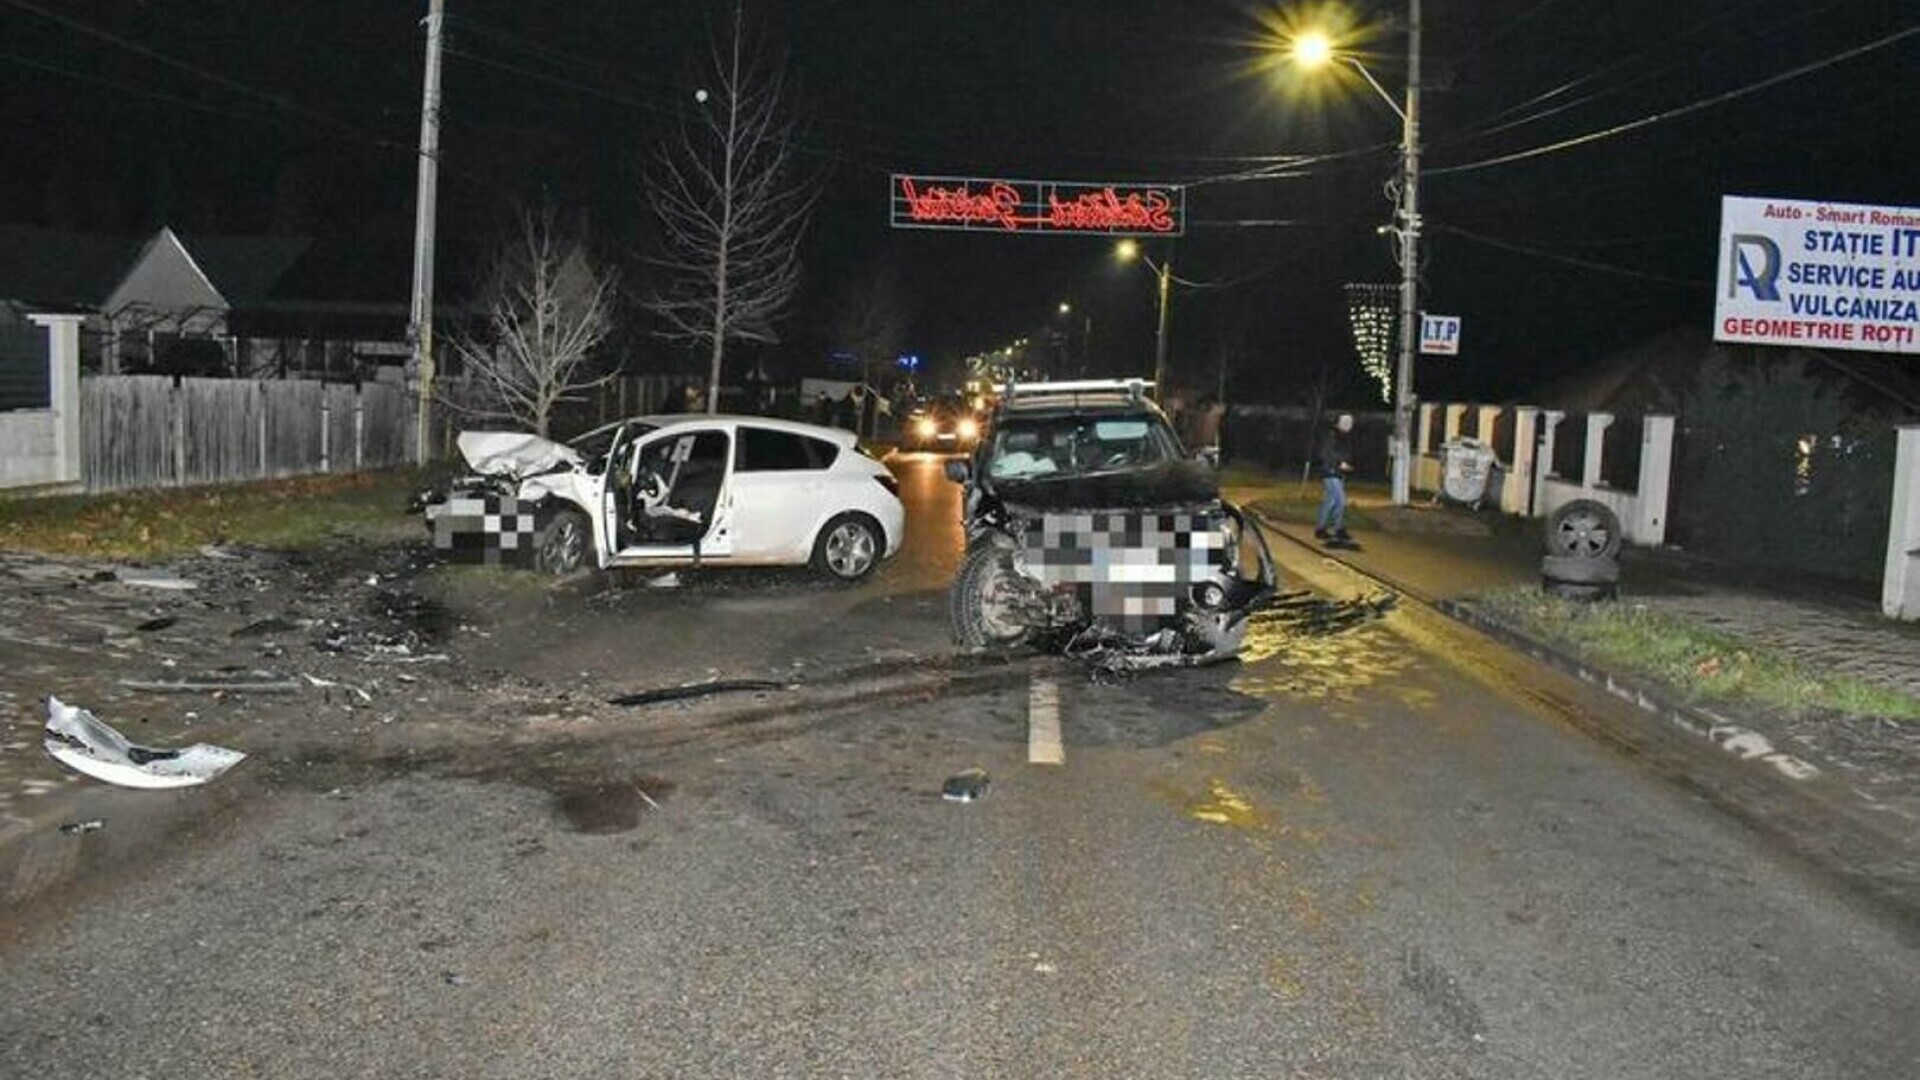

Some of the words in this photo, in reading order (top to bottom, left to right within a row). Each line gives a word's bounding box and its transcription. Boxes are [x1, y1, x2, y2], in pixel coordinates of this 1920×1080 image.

[1764, 204, 1801, 219] Auto
[1816, 206, 1865, 225] Smart
[1804, 230, 1884, 260] STAȚIE
[1788, 262, 1885, 289] SERVICE
[1789, 293, 1919, 322] VULCANIZA
[1723, 318, 1854, 341] GEOMETRIE
